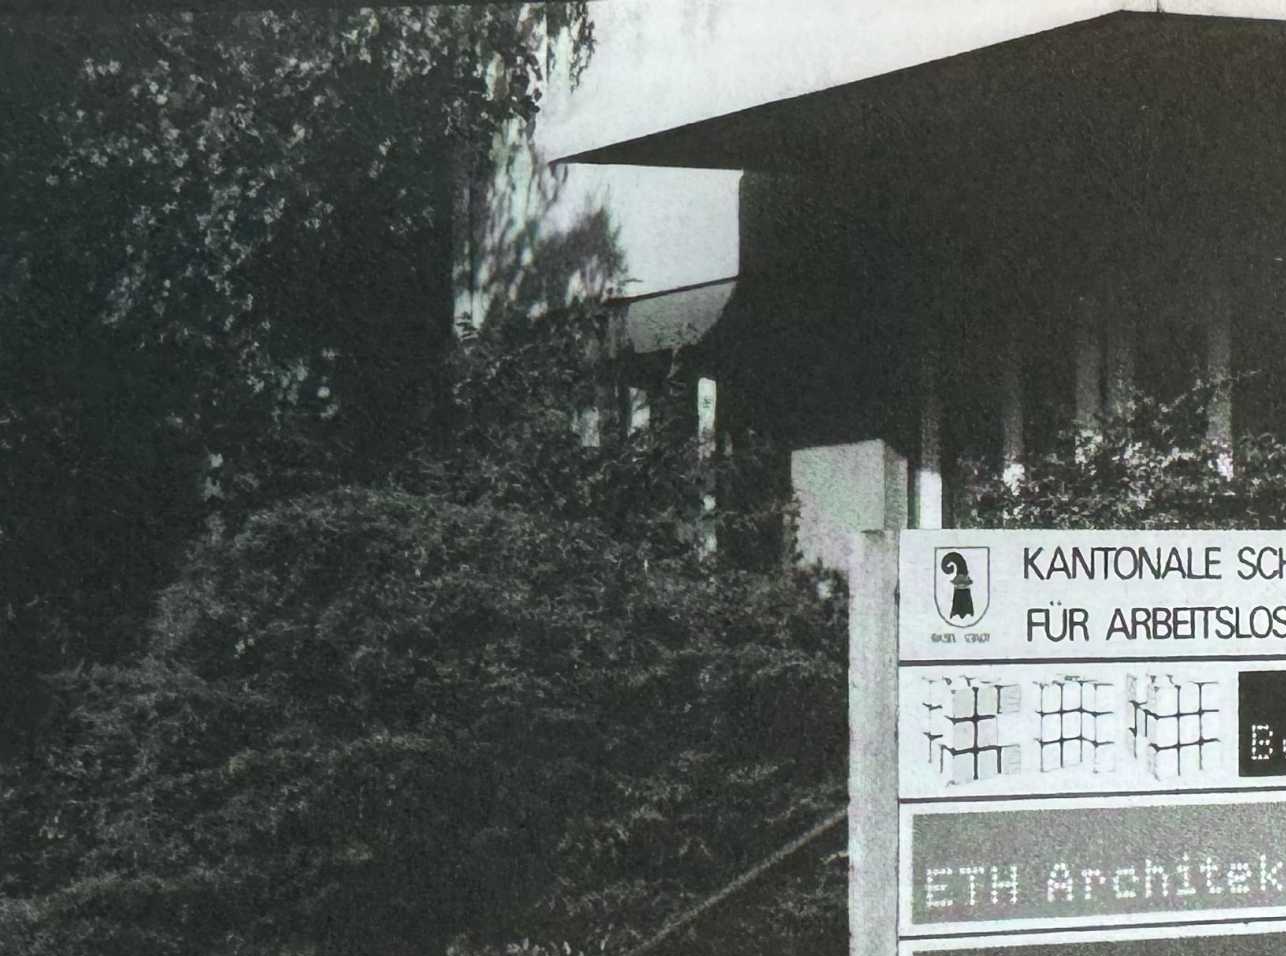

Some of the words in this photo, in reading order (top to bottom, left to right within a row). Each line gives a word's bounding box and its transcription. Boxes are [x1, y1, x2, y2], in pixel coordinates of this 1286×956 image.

[1023, 546, 1222, 580] KANTONALE
[1026, 600, 1090, 642] FÜR
[926, 864, 1018, 908] ETH
